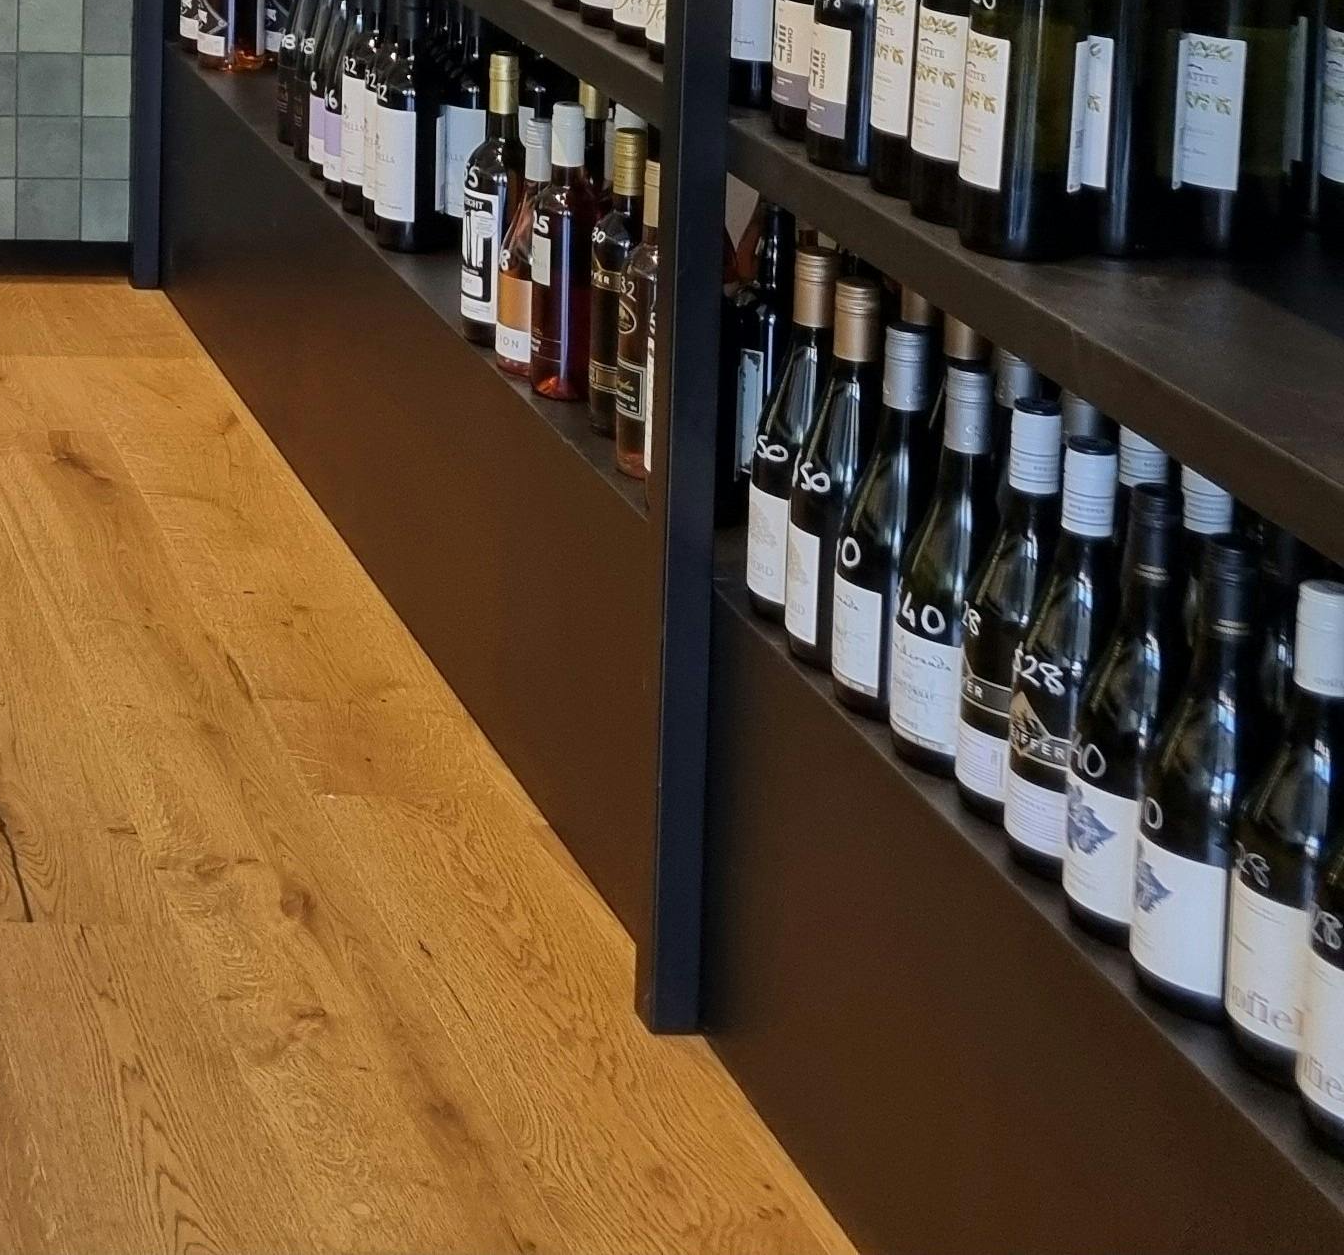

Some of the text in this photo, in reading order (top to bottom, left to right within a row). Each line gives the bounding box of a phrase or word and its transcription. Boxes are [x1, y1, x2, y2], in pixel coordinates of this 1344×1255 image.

[757, 434, 789, 463] 50
[800, 461, 830, 493] 50
[902, 591, 947, 636] 40
